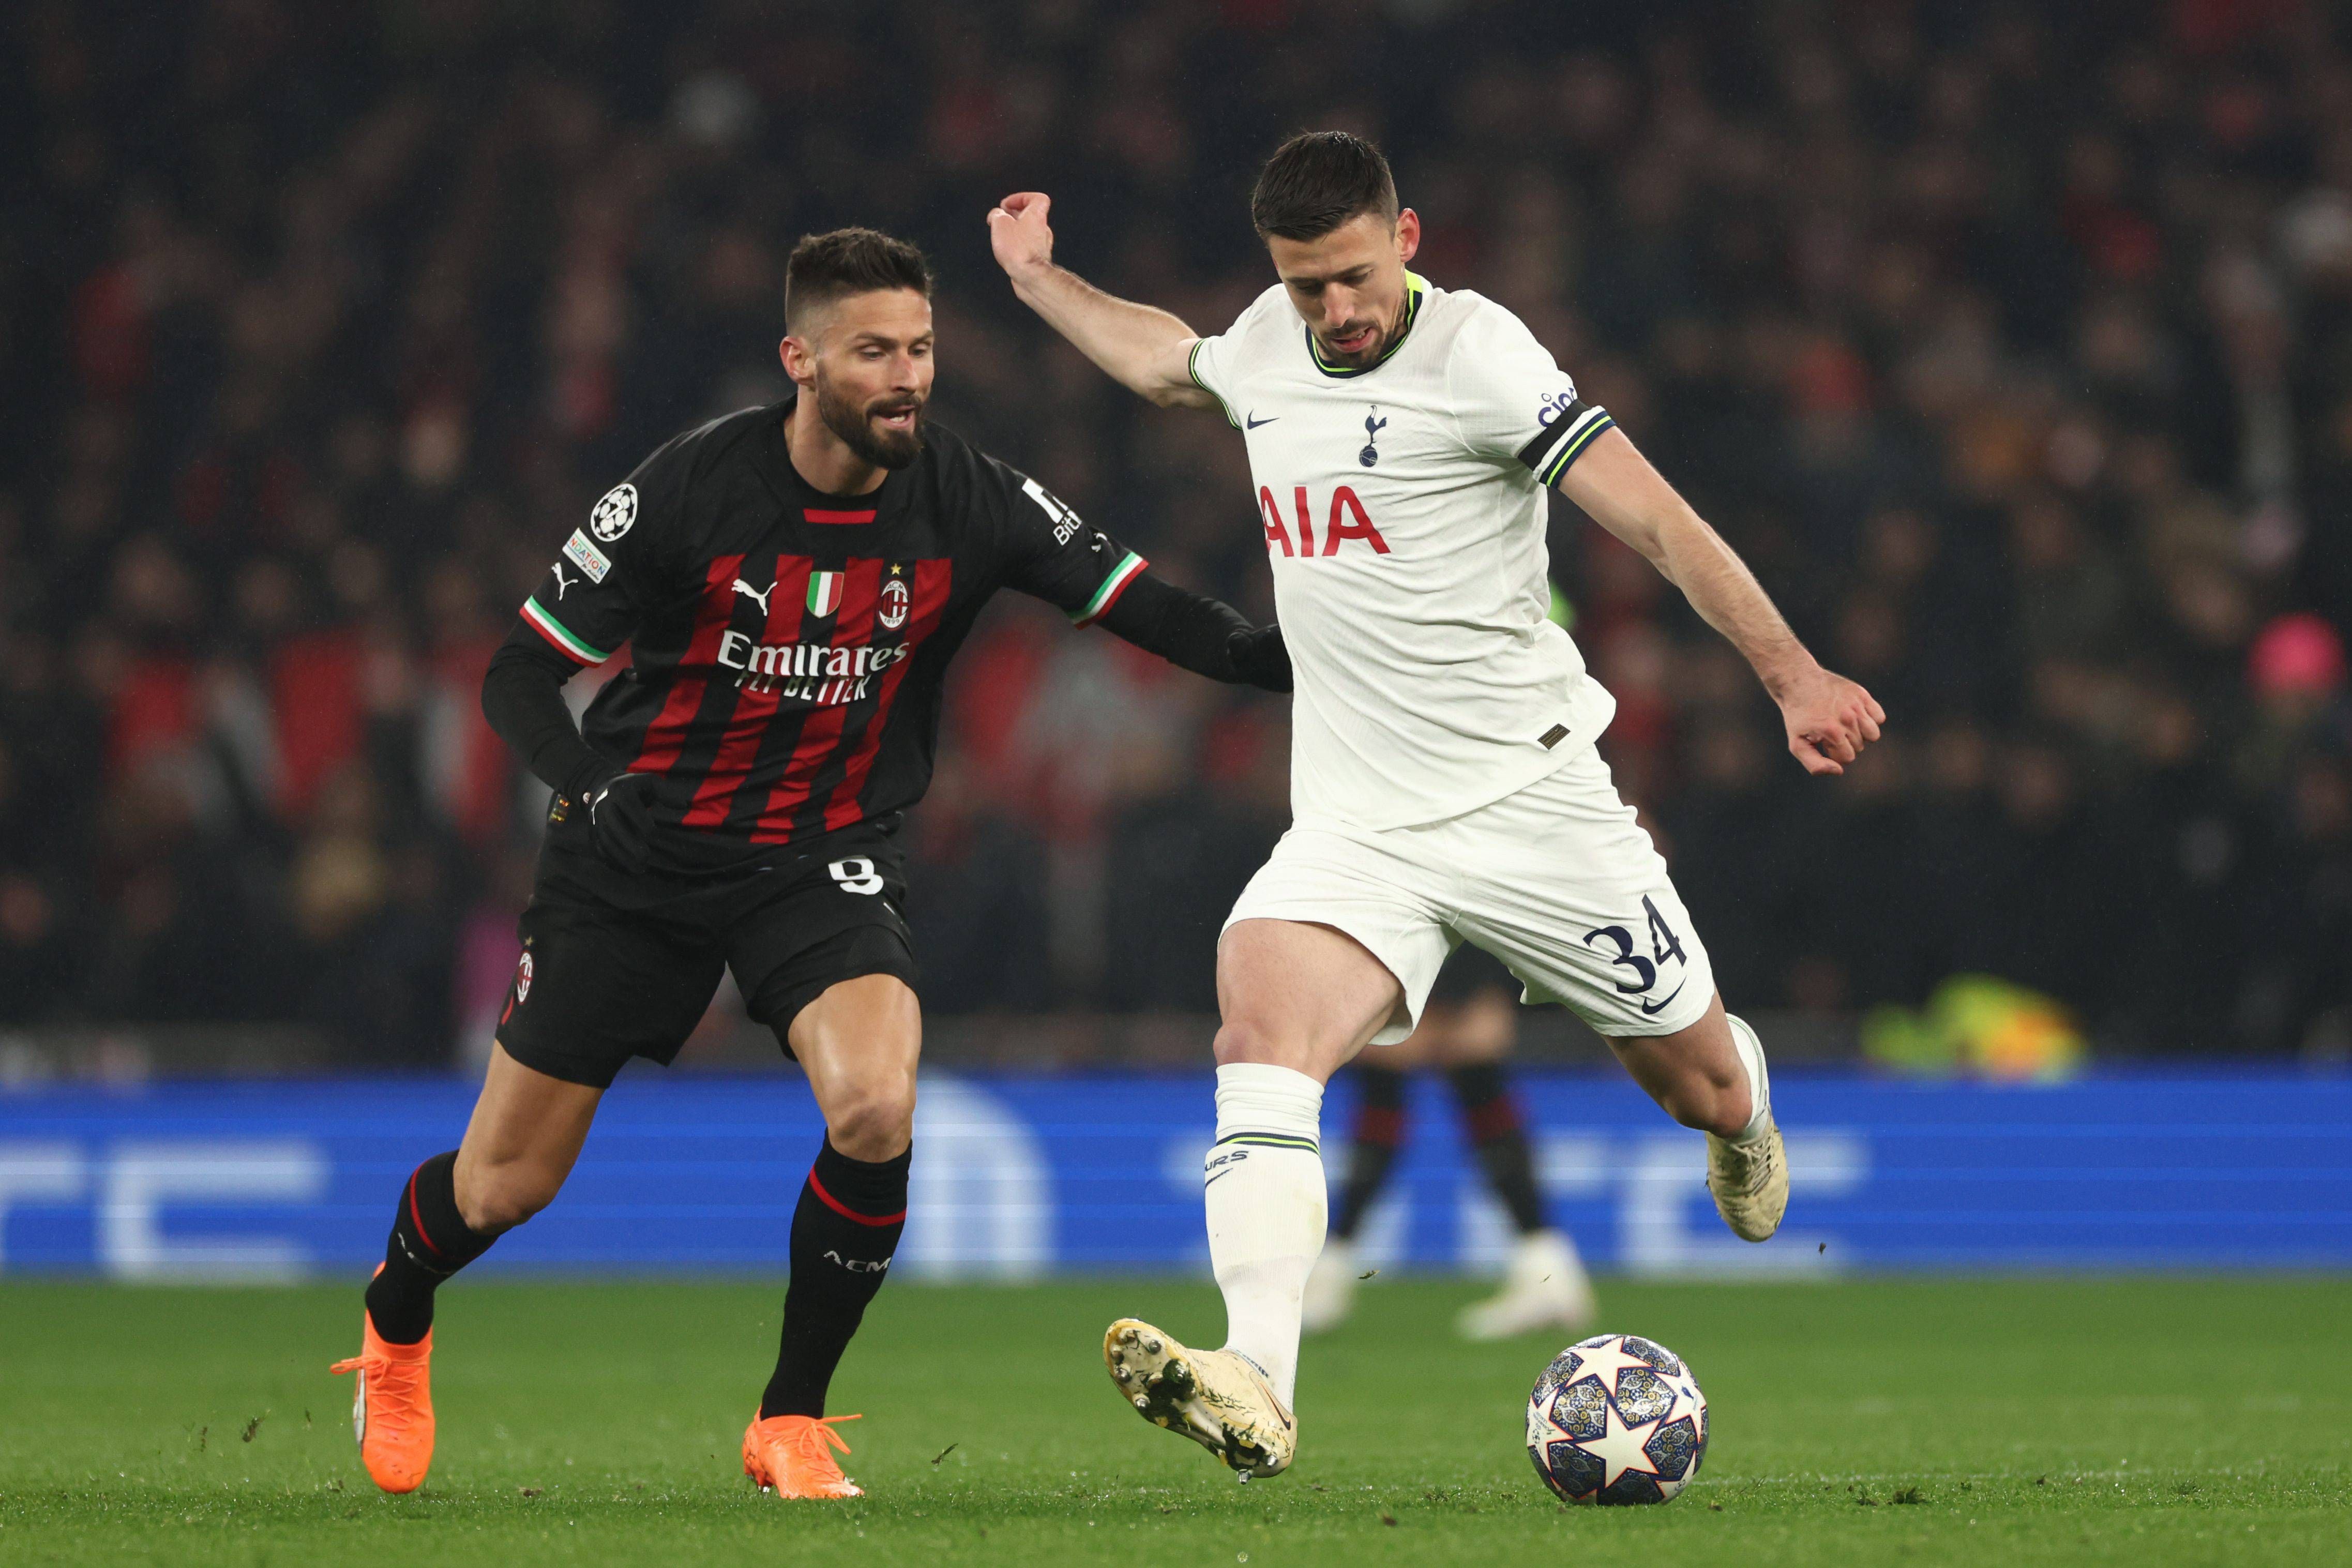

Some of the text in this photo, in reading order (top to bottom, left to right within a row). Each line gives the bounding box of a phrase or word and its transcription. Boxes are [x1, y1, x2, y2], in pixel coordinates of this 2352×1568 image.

[1260, 486, 1391, 557] AIA
[887, 582, 904, 592] ACM
[717, 629, 910, 676] Emirates
[734, 671, 872, 705] FLY BETTER
[1582, 893, 1687, 994] 34
